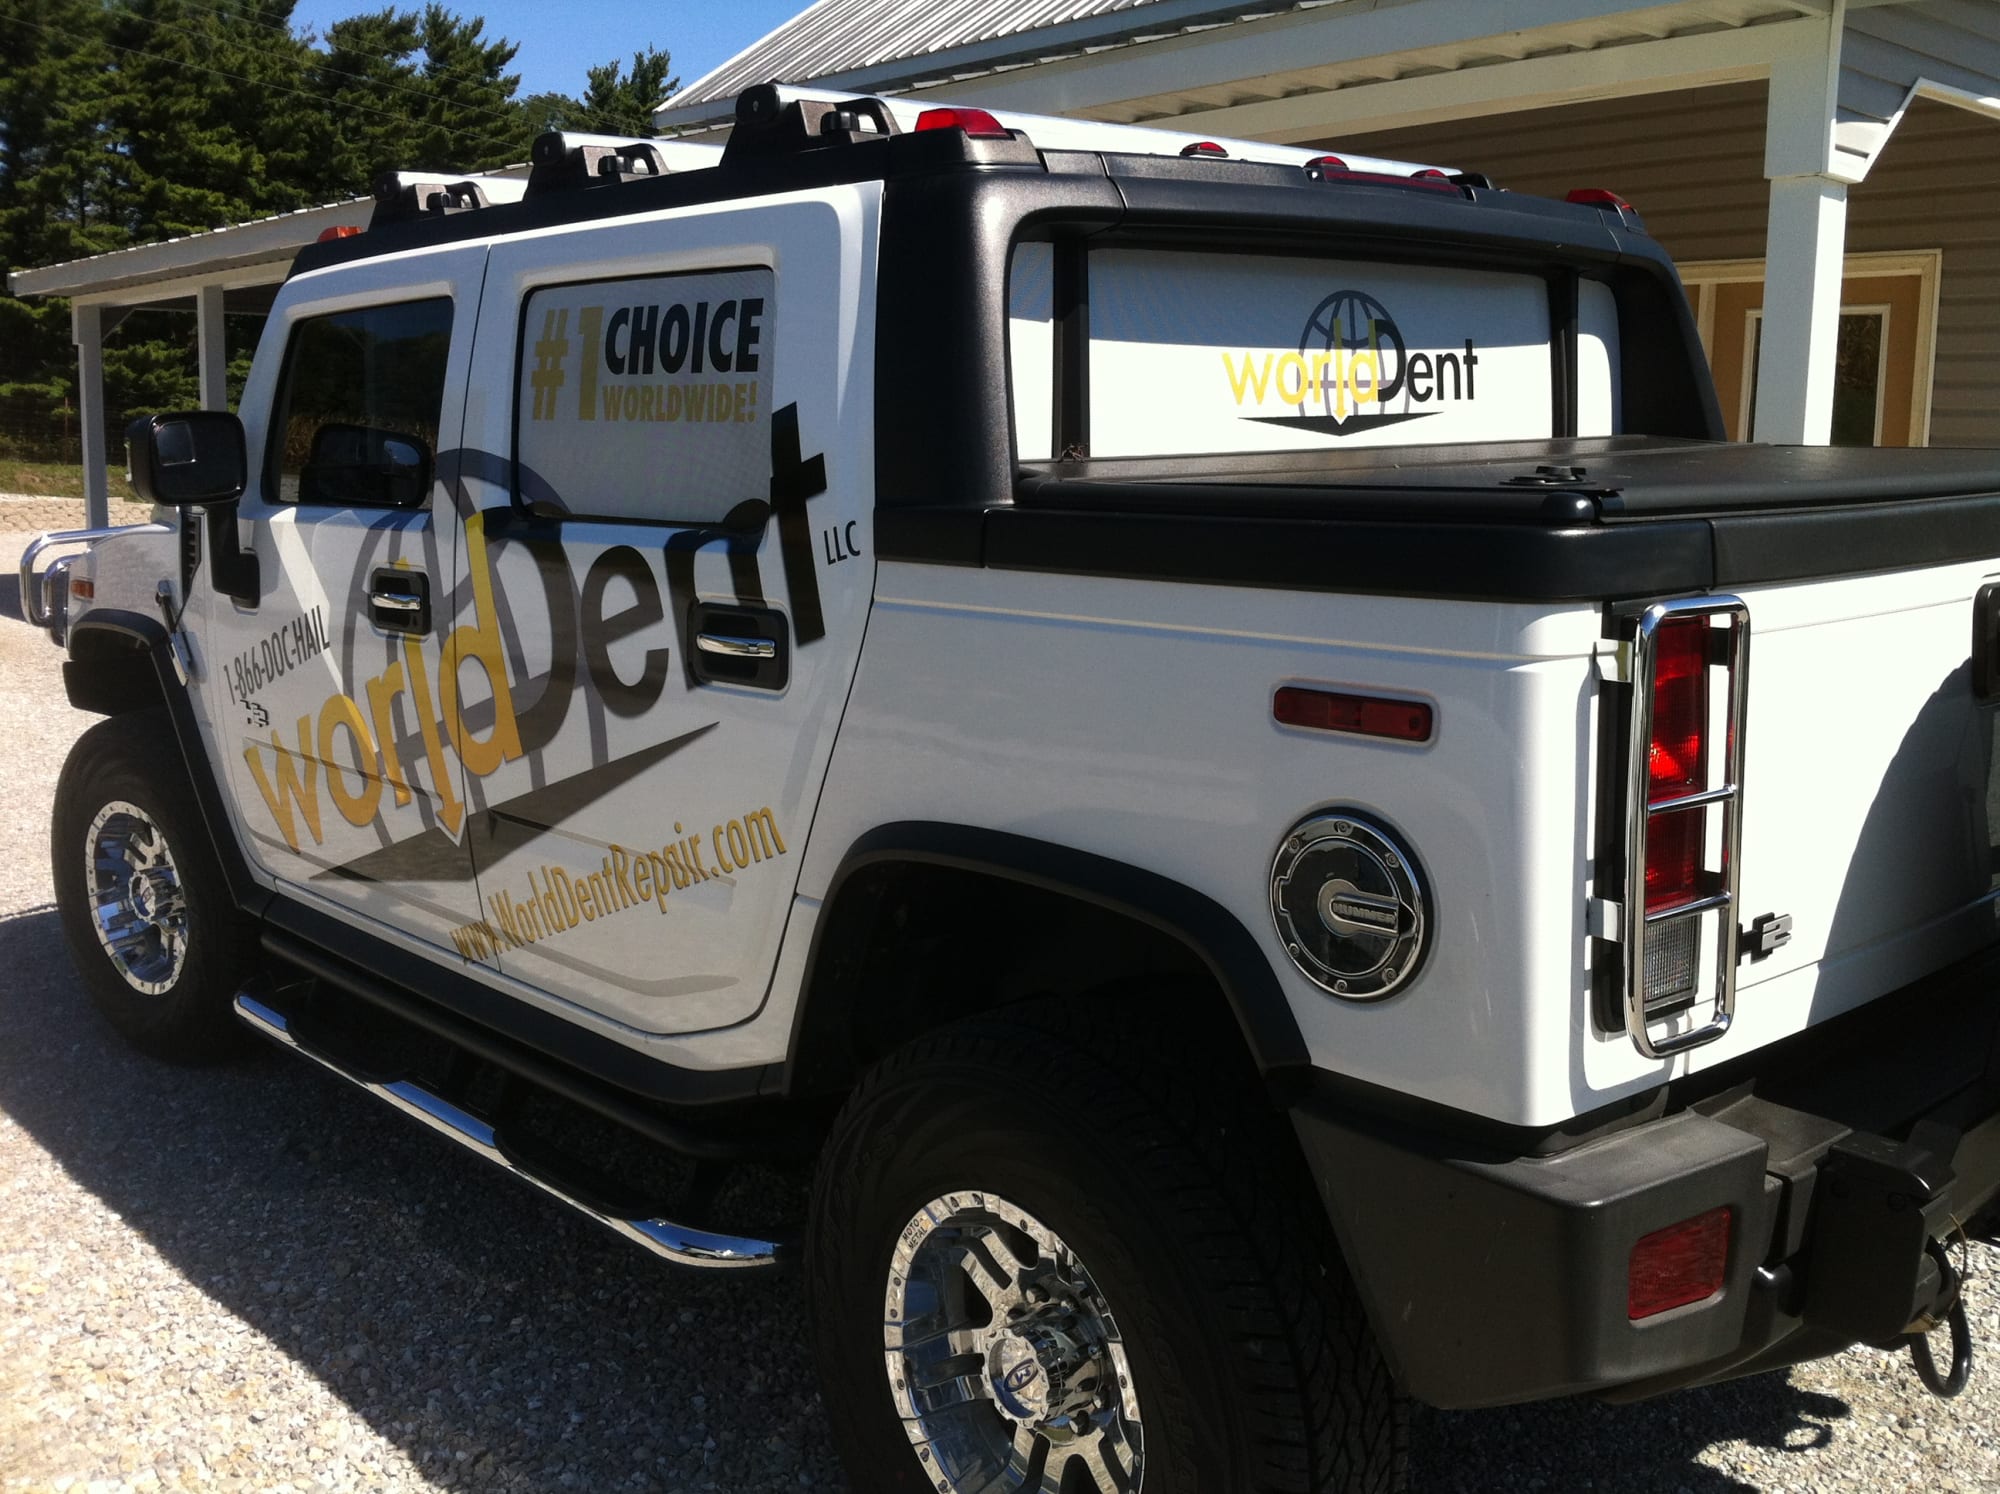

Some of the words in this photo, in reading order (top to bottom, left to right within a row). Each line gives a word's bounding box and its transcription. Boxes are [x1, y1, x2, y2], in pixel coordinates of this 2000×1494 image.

[531, 306, 604, 421] #1
[604, 298, 765, 376] CHOICE
[602, 381, 758, 423] WORLDWIDE!
[823, 520, 861, 566] LLC
[223, 604, 330, 705] 1-866-DOC-HAIL
[449, 806, 788, 962] www.WorldDentRepair.com
[1331, 902, 1397, 925] HUMMER
[902, 1218, 920, 1243] MOTO
[907, 1227, 928, 1249] METAL
